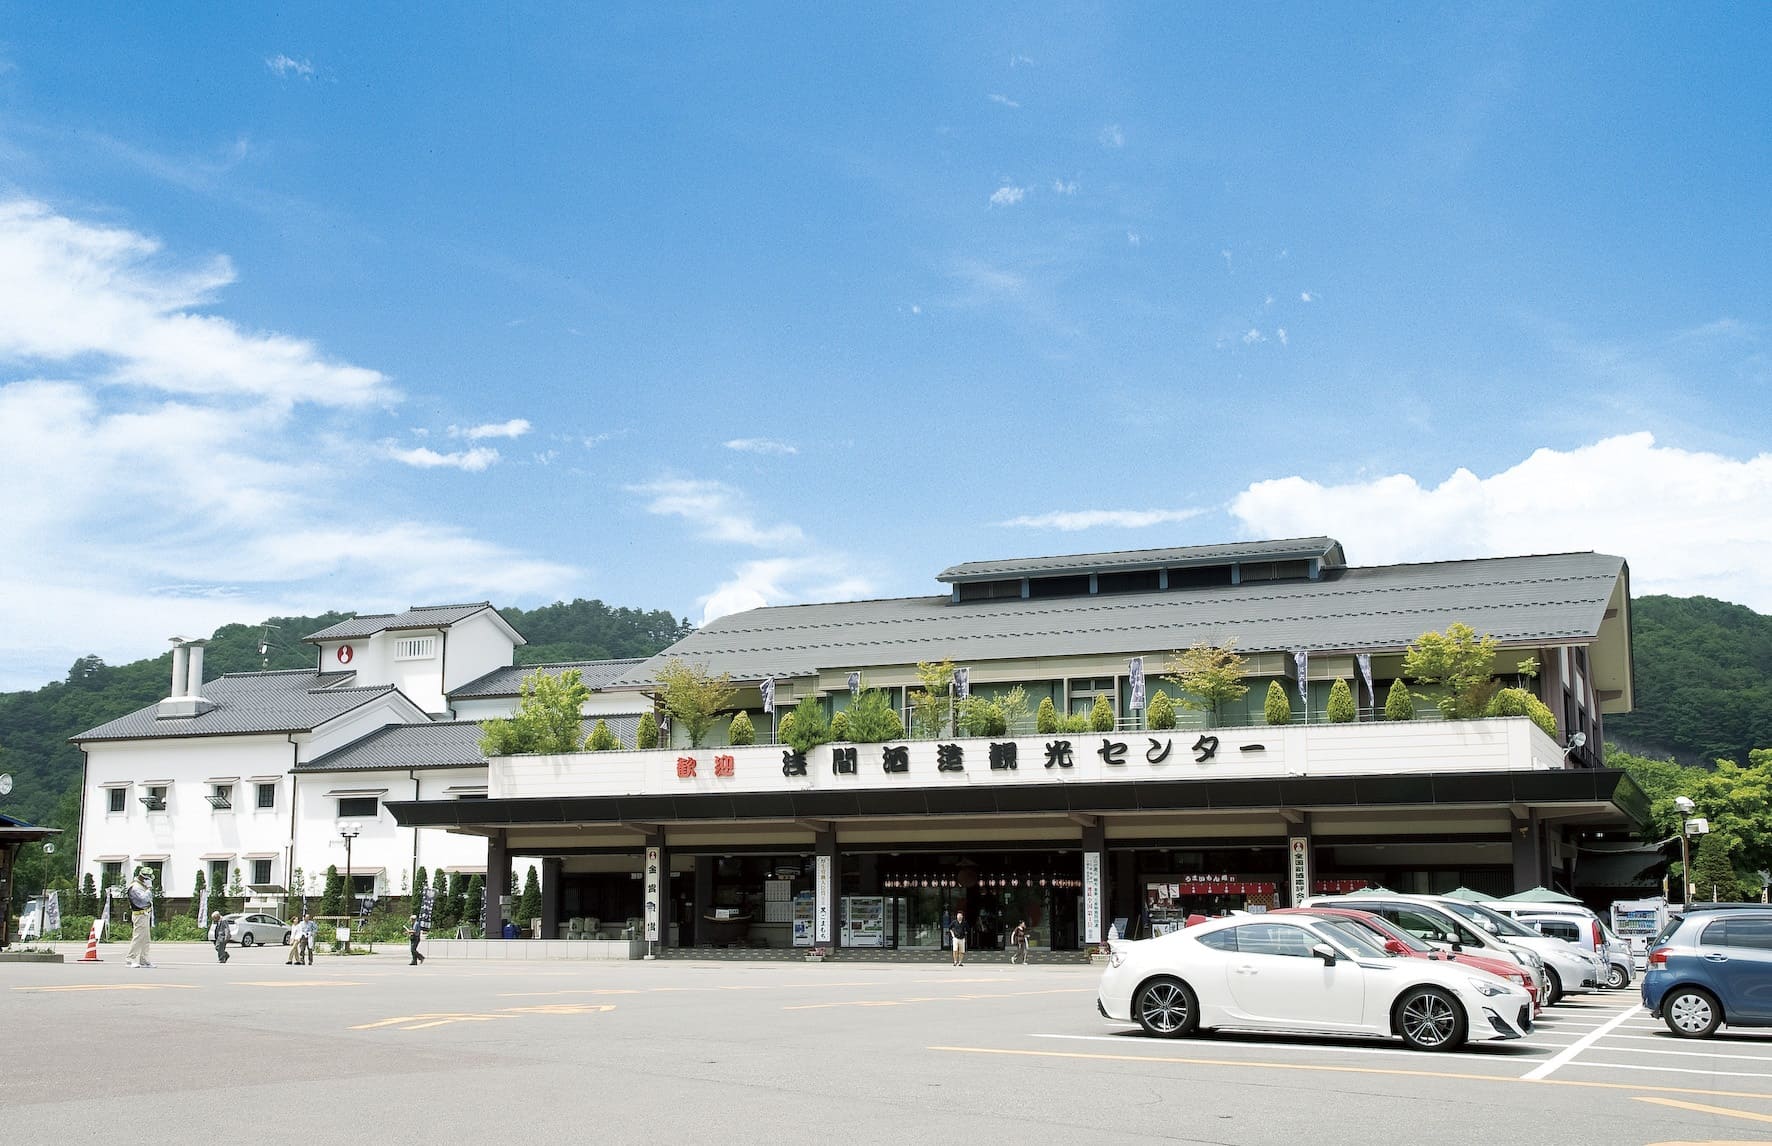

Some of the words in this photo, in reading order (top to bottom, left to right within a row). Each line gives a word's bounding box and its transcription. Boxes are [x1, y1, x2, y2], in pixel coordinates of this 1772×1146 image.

[677, 755, 735, 777] 歓迎
[783, 735, 1265, 776] 浅間酒造観光センター
